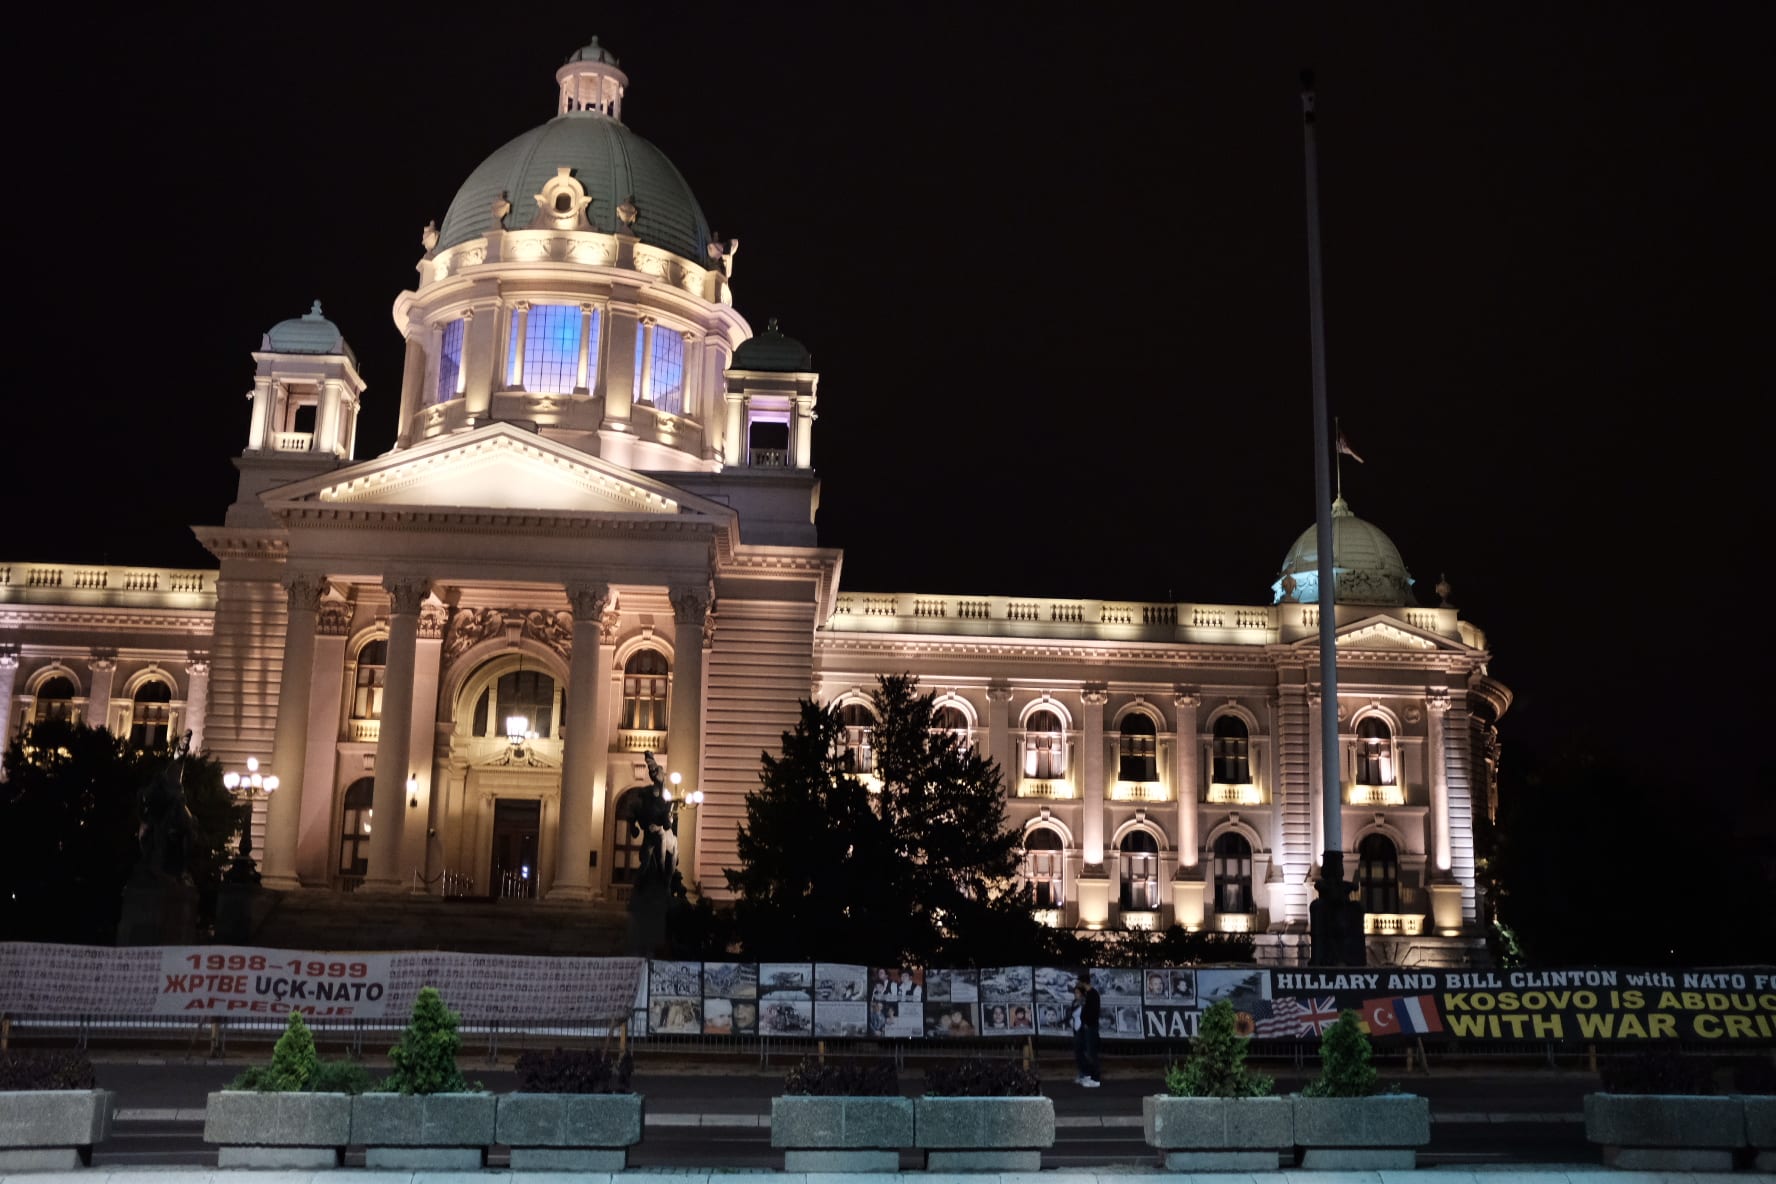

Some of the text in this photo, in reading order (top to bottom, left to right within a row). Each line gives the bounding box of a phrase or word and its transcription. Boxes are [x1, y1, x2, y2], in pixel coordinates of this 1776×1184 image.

[163, 974, 249, 994] ЖРТВЕ
[1277, 973, 1381, 990] HILLARY
[1387, 973, 1437, 990] AND
[1446, 972, 1502, 990] BILL
[1510, 970, 1618, 988] CLINTON
[1626, 972, 1676, 988] with
[1683, 973, 1746, 990] NATO
[1443, 990, 1776, 1012] KOSOVO IS ABDUC
[1145, 1010, 1203, 1038] NAT
[1445, 1013, 1776, 1039] WITH WAR CRI
